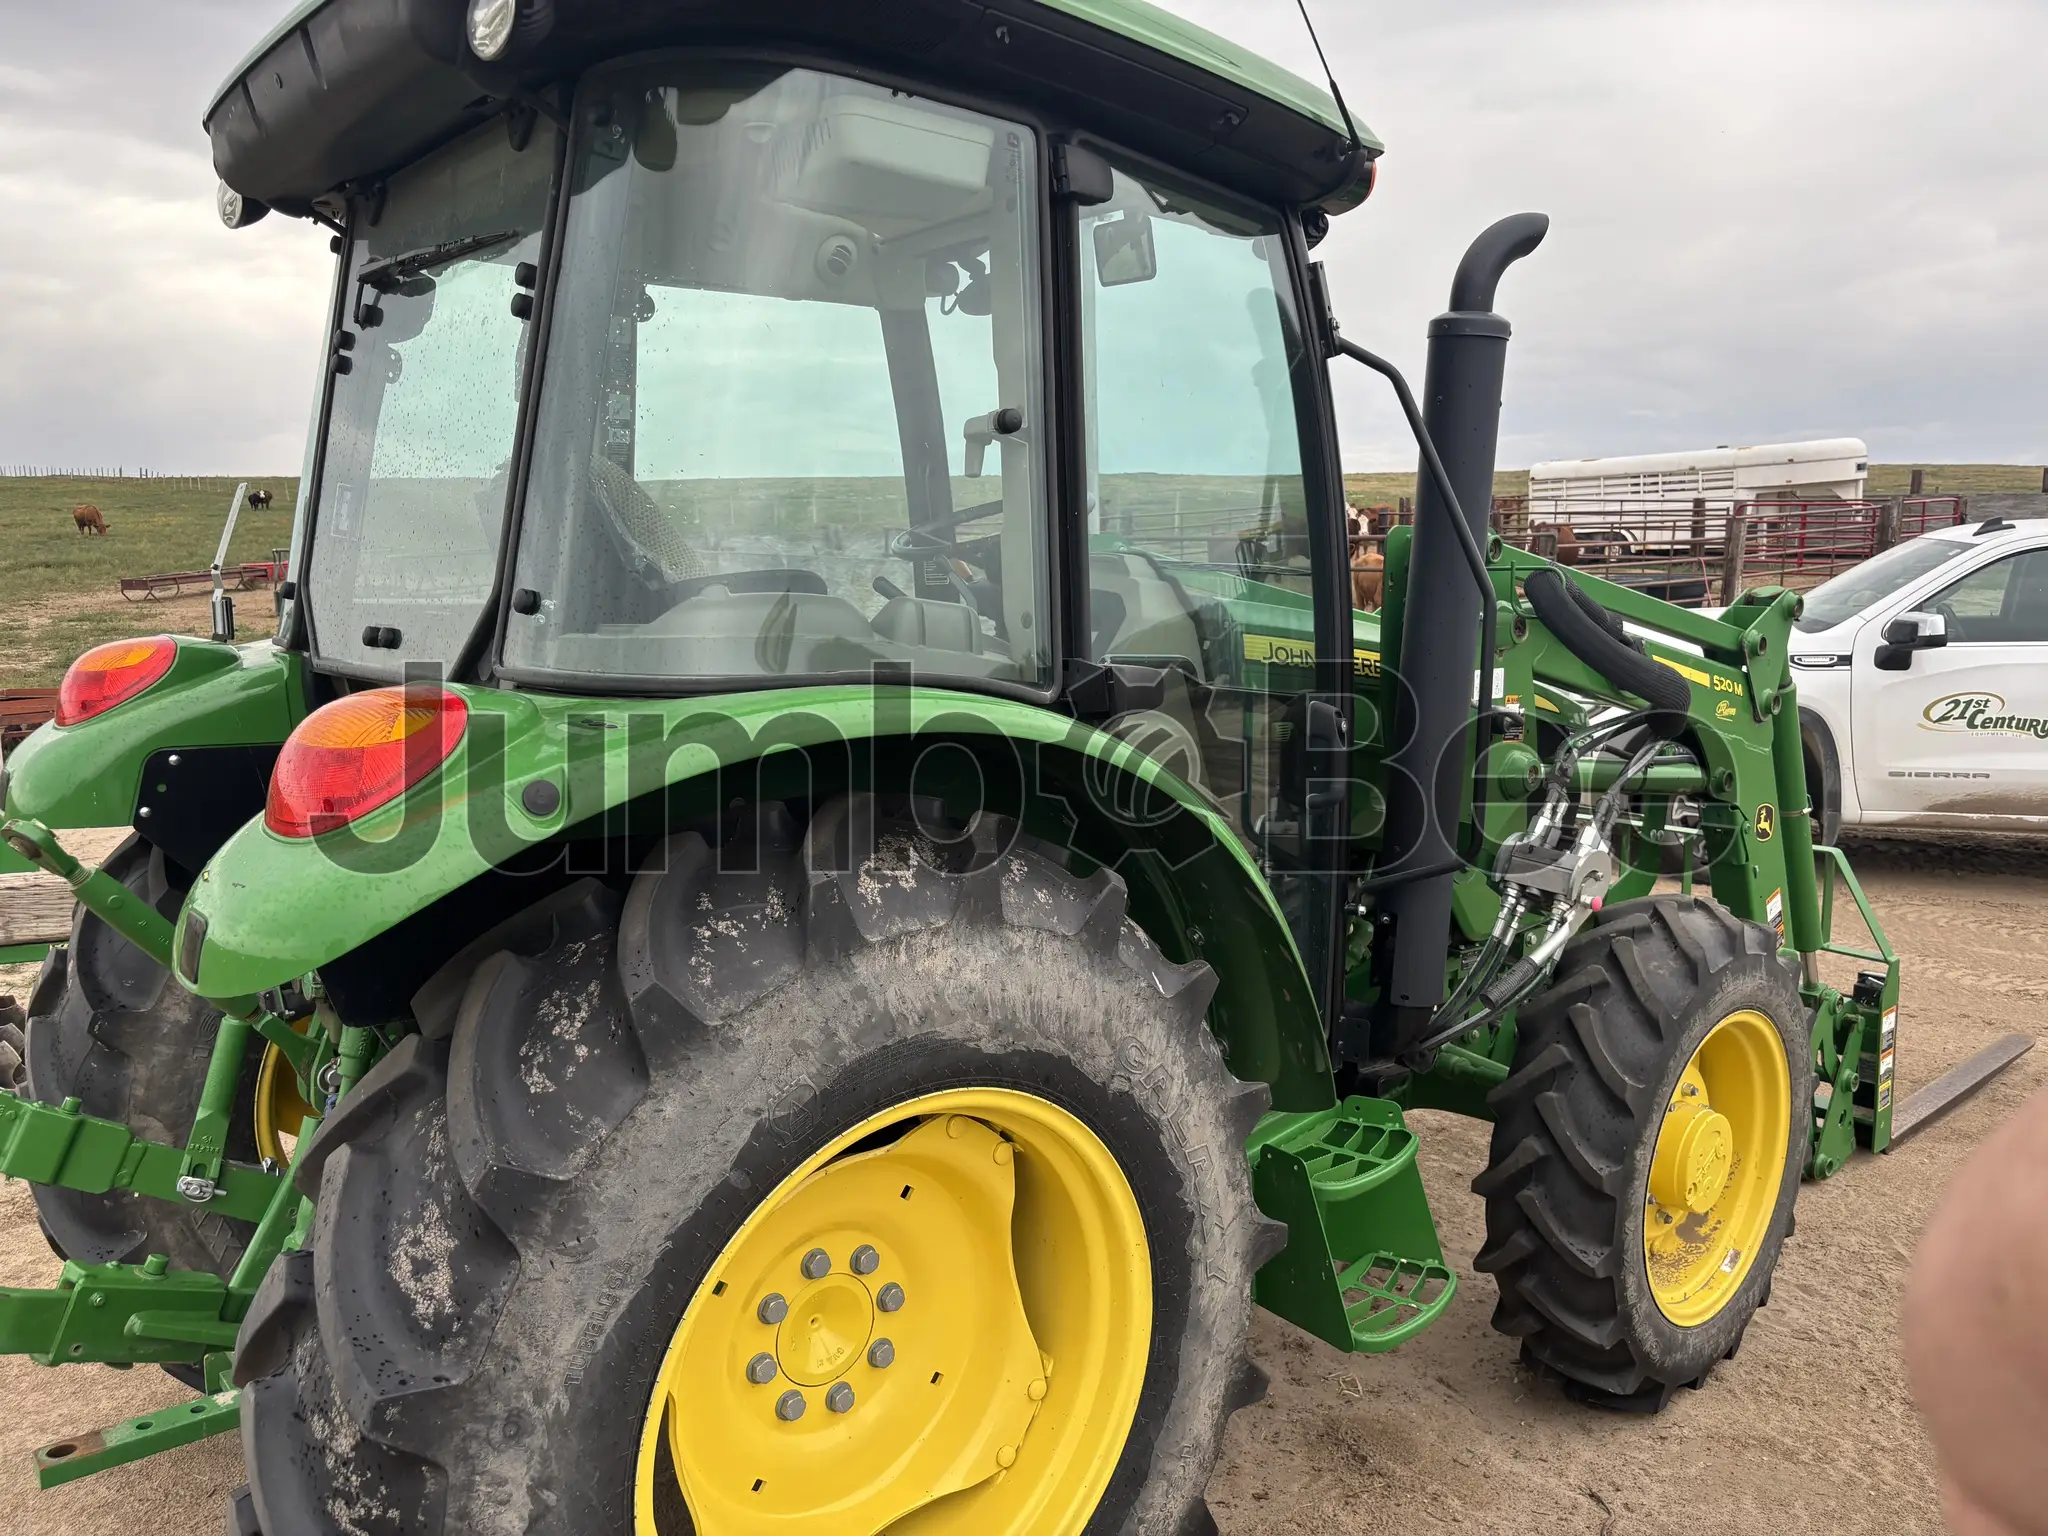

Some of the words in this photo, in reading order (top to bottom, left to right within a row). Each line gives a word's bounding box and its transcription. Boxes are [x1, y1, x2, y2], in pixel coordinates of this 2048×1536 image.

[1933, 697, 1991, 724] 21st
[1888, 771, 1990, 779] SIERRA
[563, 1256, 633, 1388] TUBELESS
